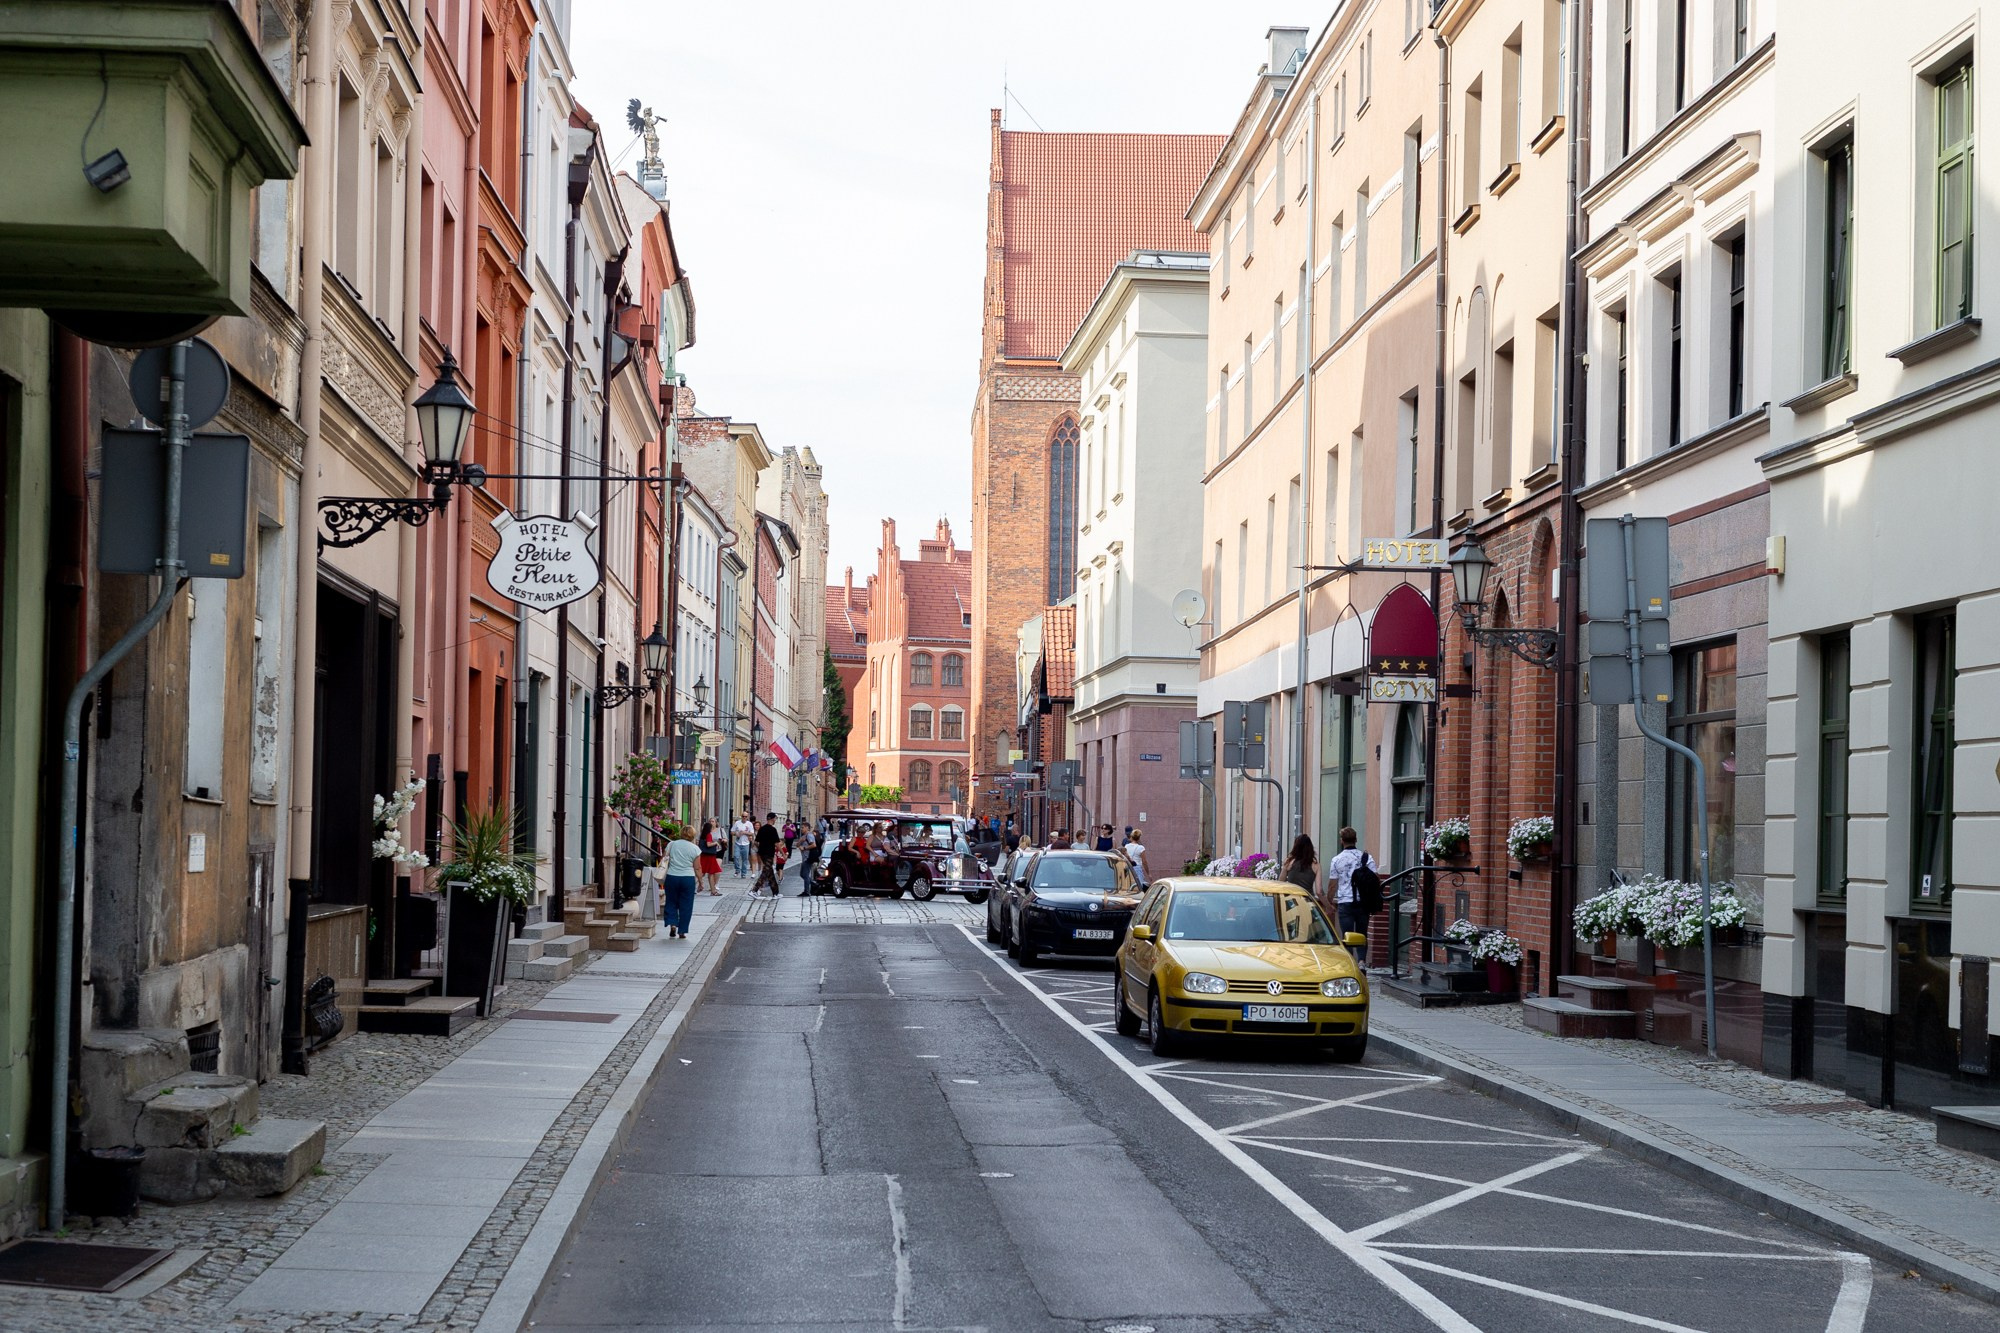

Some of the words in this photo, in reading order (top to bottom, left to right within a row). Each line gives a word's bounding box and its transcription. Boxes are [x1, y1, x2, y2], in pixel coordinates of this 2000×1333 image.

[519, 523, 569, 537] HOTEL
[515, 543, 572, 562] Petite
[1366, 540, 1446, 564] HOTEL
[512, 562, 578, 584] Fleur
[507, 584, 581, 602] RESTAURACJA
[1373, 679, 1435, 699] GOTYK
[1077, 930, 1087, 938] WA
[1250, 1006, 1267, 1018] PO
[1272, 1007, 1306, 1019] 160HS
